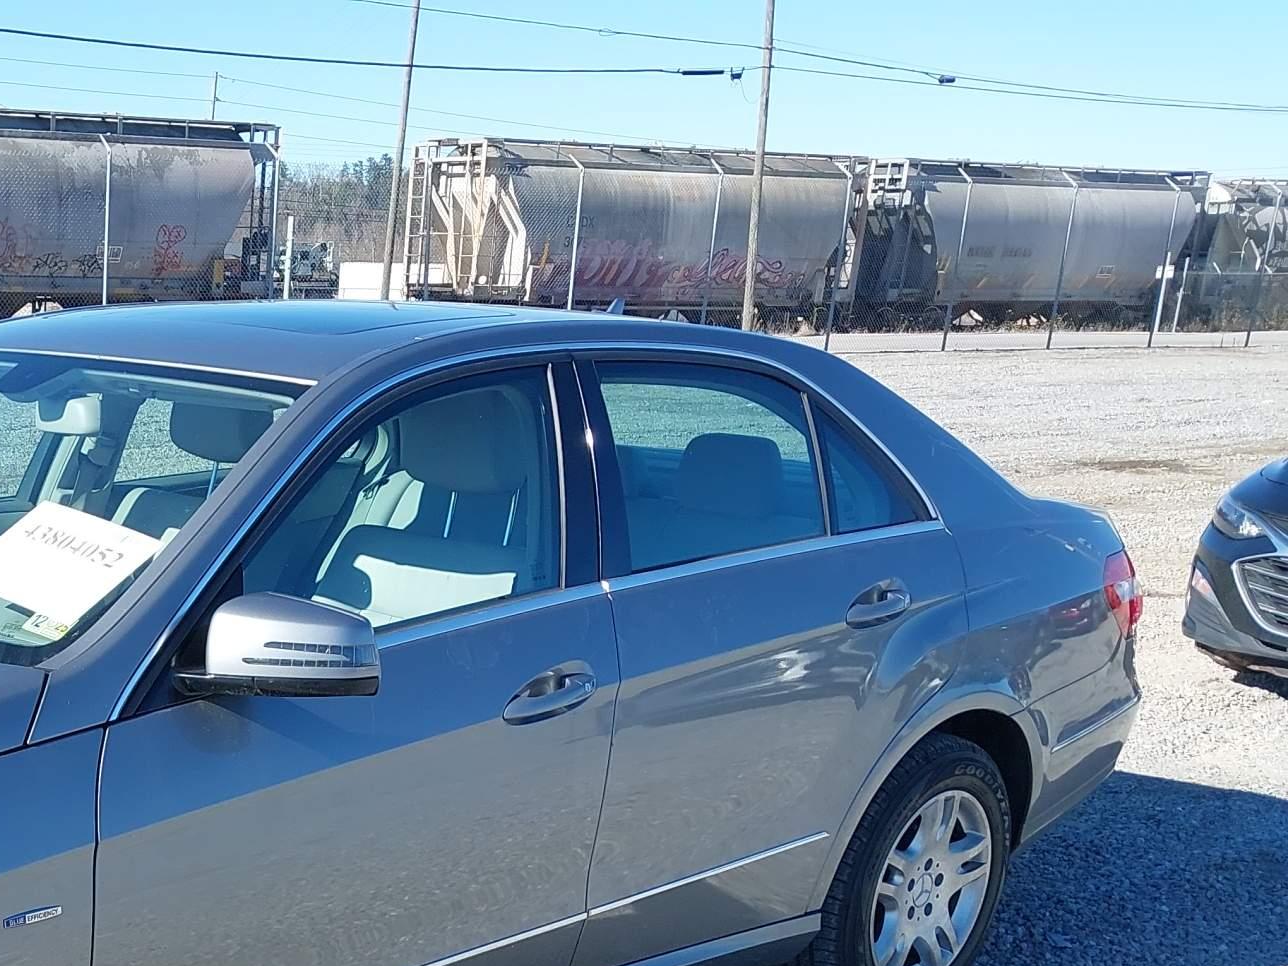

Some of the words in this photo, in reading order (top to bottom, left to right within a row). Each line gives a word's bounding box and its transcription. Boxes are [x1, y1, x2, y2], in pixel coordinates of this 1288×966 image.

[24, 524, 124, 568] 43804052
[30, 614, 49, 628] 12
[28, 908, 58, 921] EFFICIENCY
